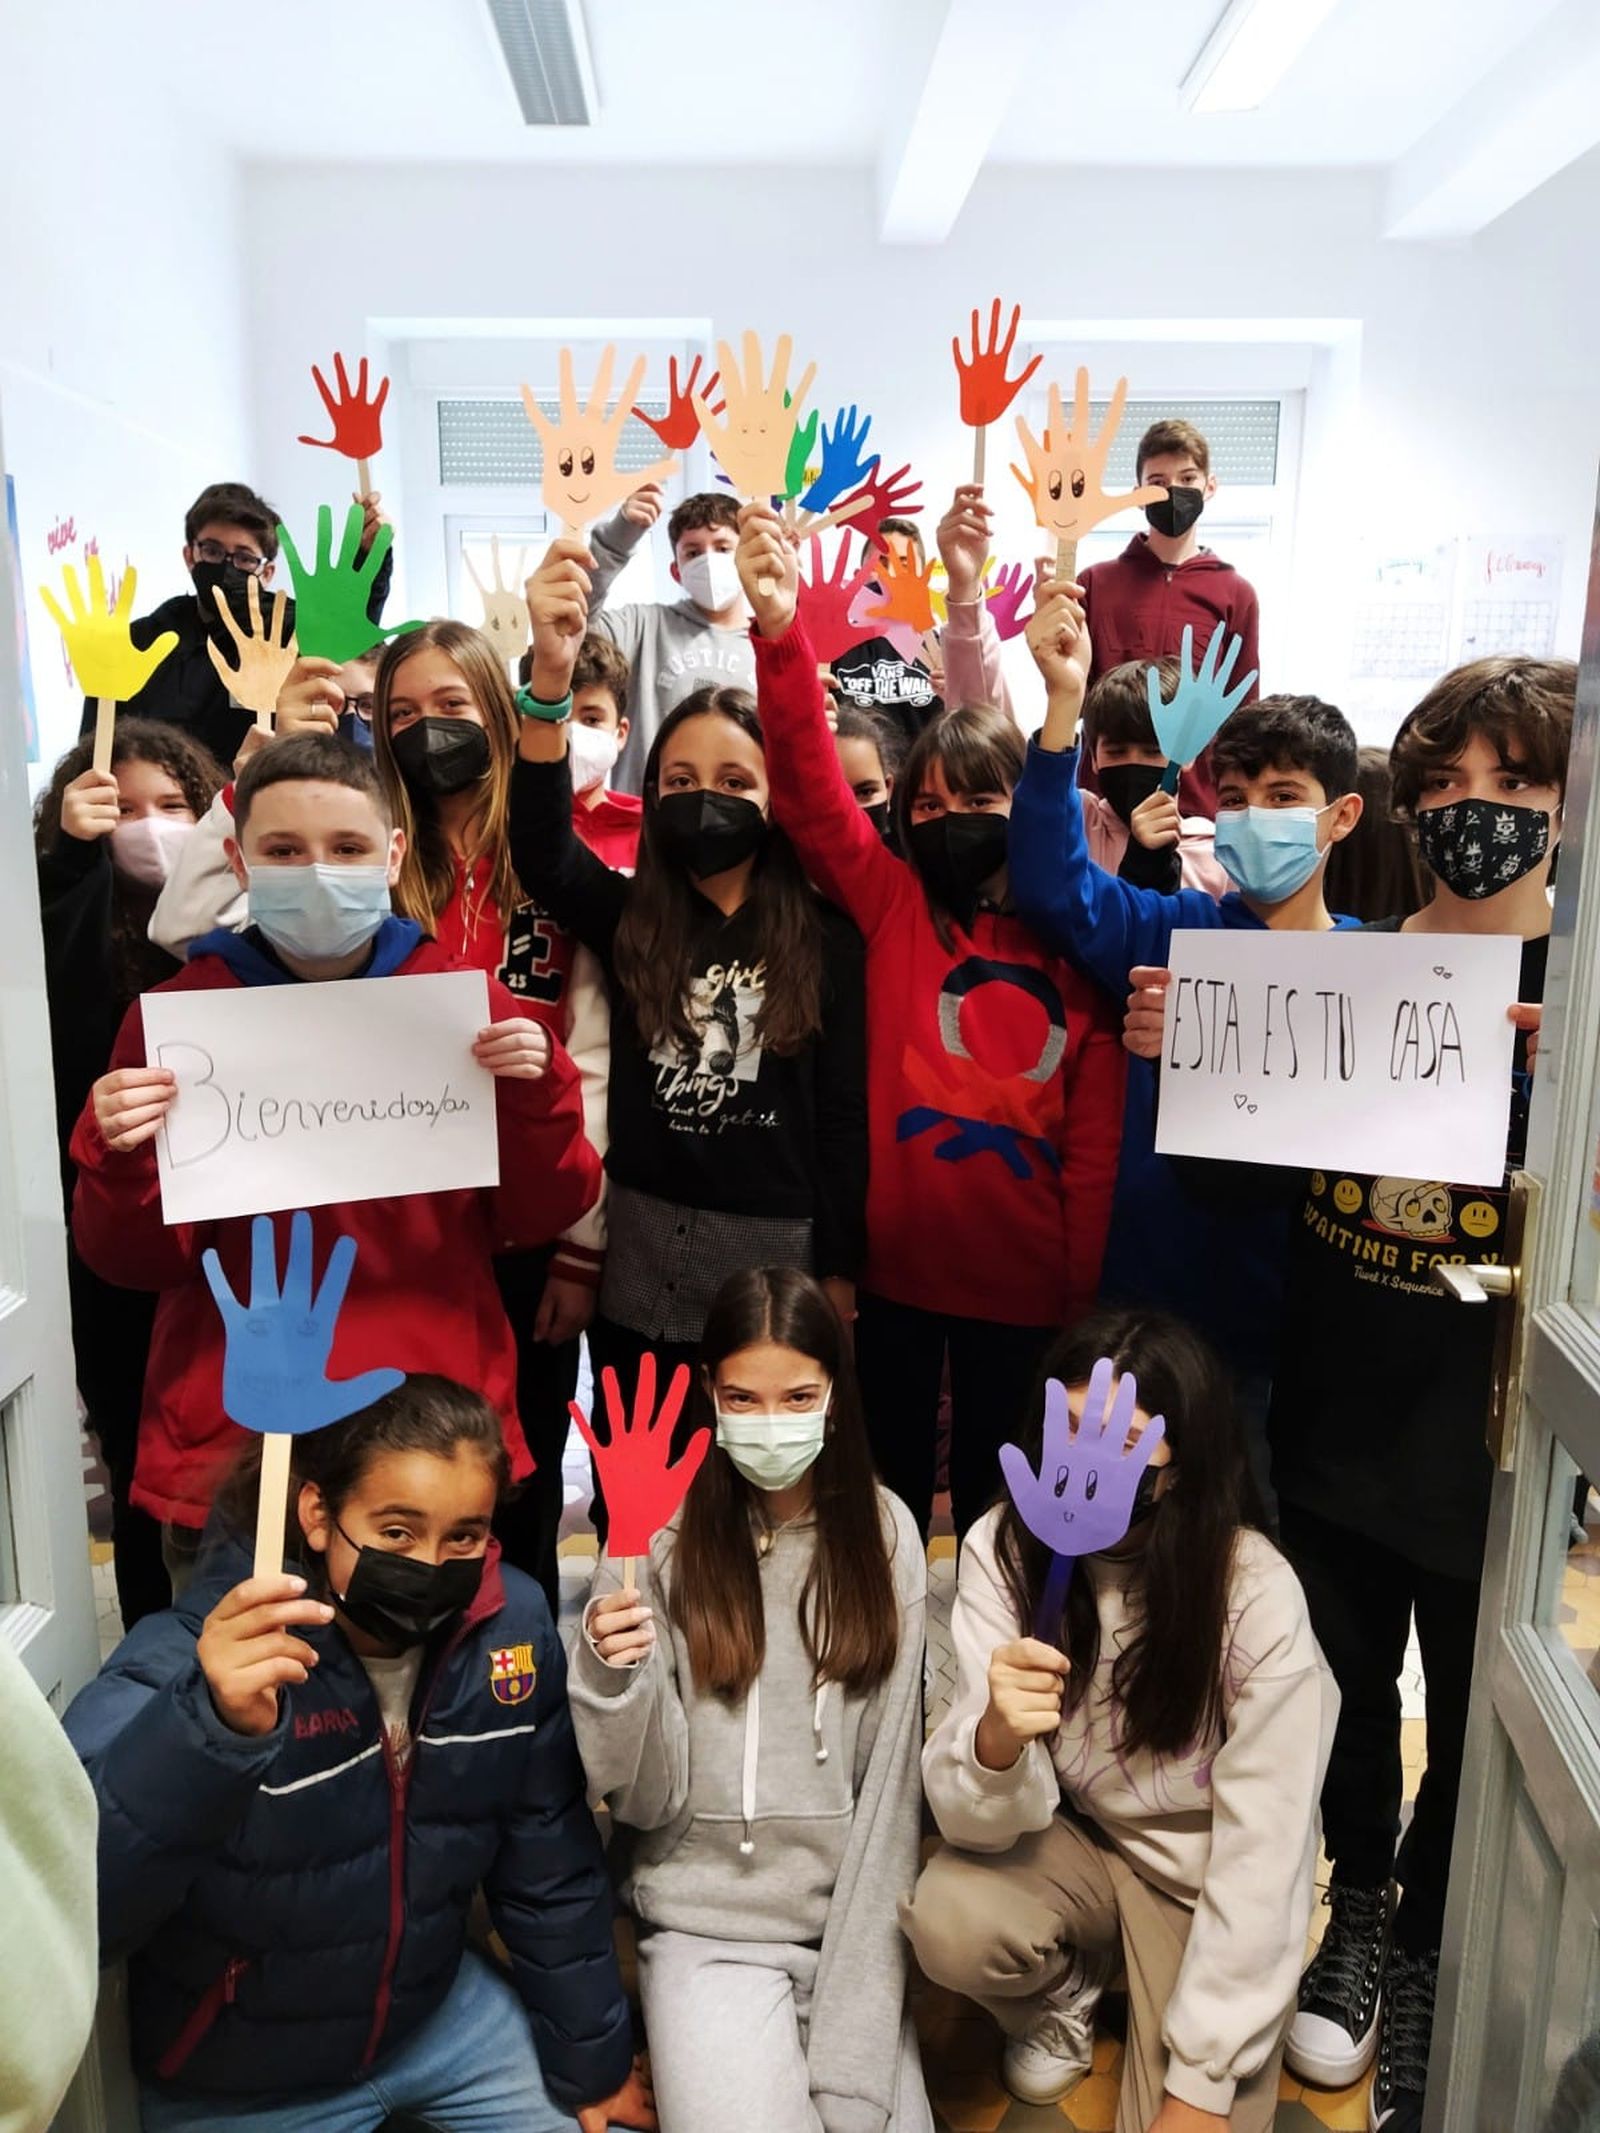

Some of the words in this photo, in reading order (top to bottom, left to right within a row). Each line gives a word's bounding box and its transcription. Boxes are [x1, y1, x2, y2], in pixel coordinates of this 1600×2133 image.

[871, 664, 905, 680] VANS
[875, 678, 897, 698] THE
[507, 973, 528, 989] 25
[1170, 977, 1241, 1075] ESTA
[1262, 984, 1299, 1079] ES
[1315, 991, 1356, 1082] TU
[1390, 1000, 1465, 1087] CASA
[1304, 1201, 1399, 1269] WAITING
[1389, 1274, 1445, 1297] Sequence
